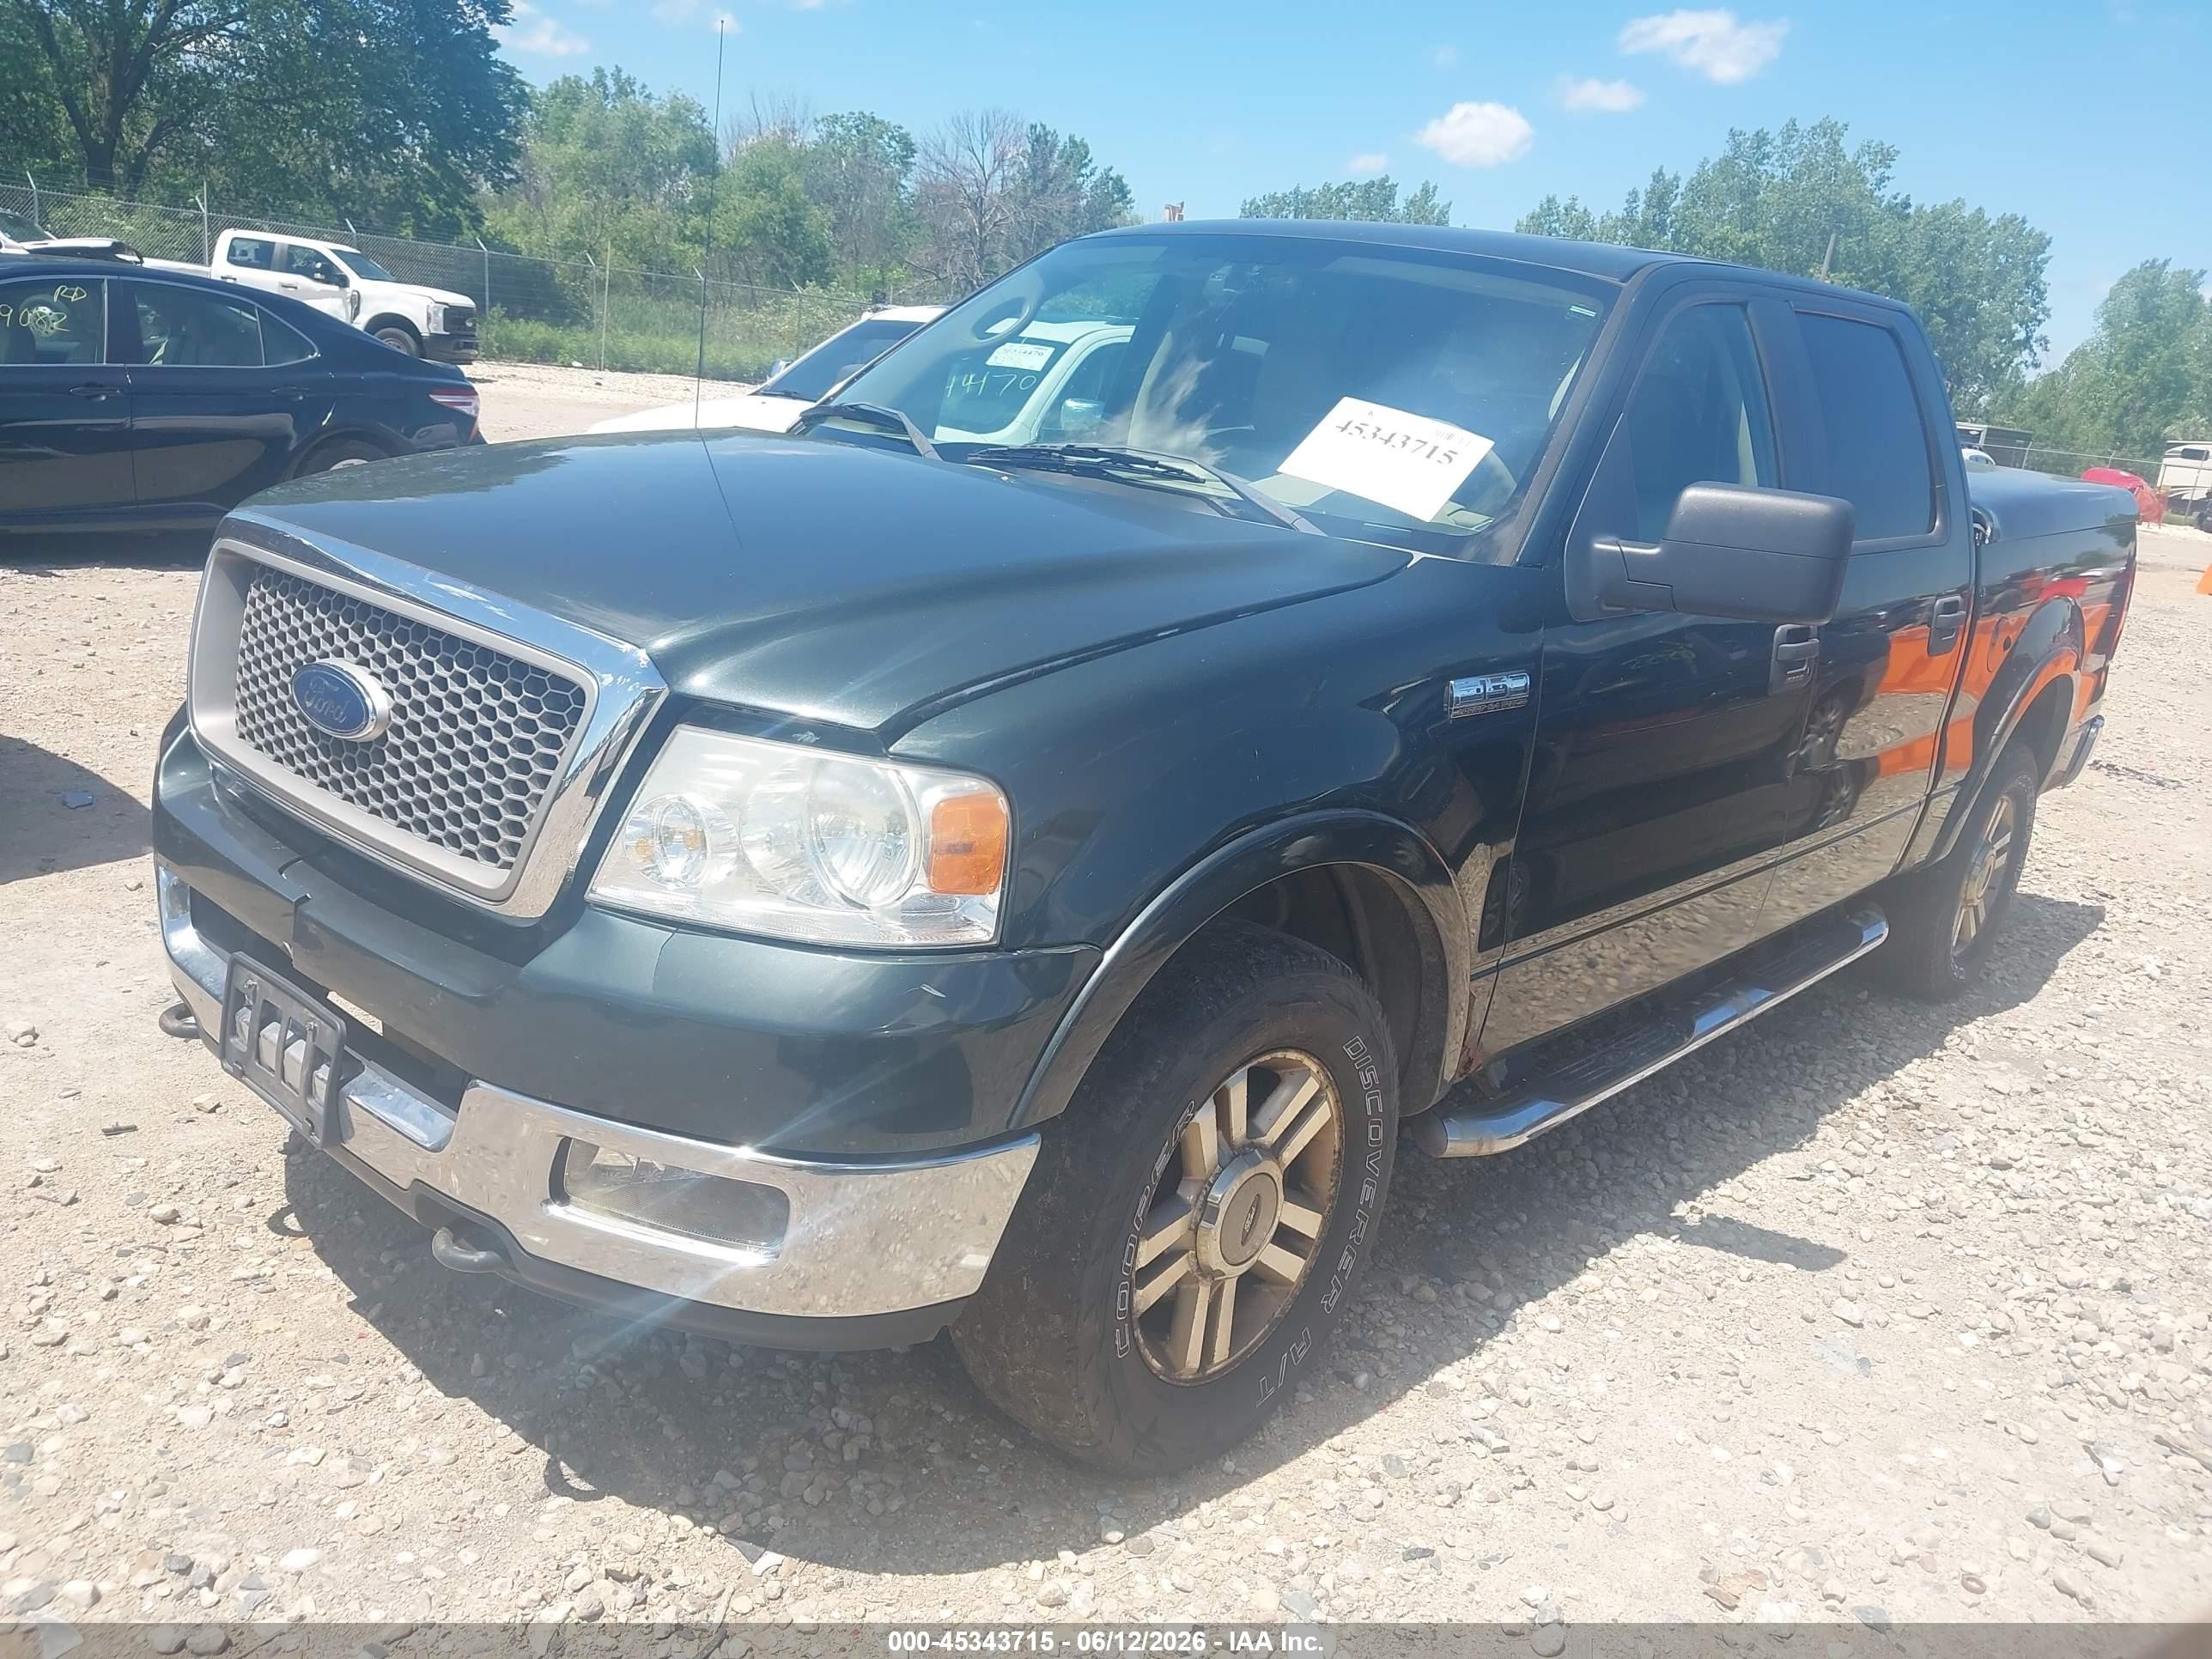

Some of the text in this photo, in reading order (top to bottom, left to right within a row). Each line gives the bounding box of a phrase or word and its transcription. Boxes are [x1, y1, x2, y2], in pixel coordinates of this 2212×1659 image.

[1334, 419, 1459, 466] 45343715
[304, 678, 351, 723] Ford
[1321, 1036, 1384, 1314] DISCOVERER
[1116, 1100, 1194, 1358] COOPER
[1256, 1328, 1312, 1408] A/T
